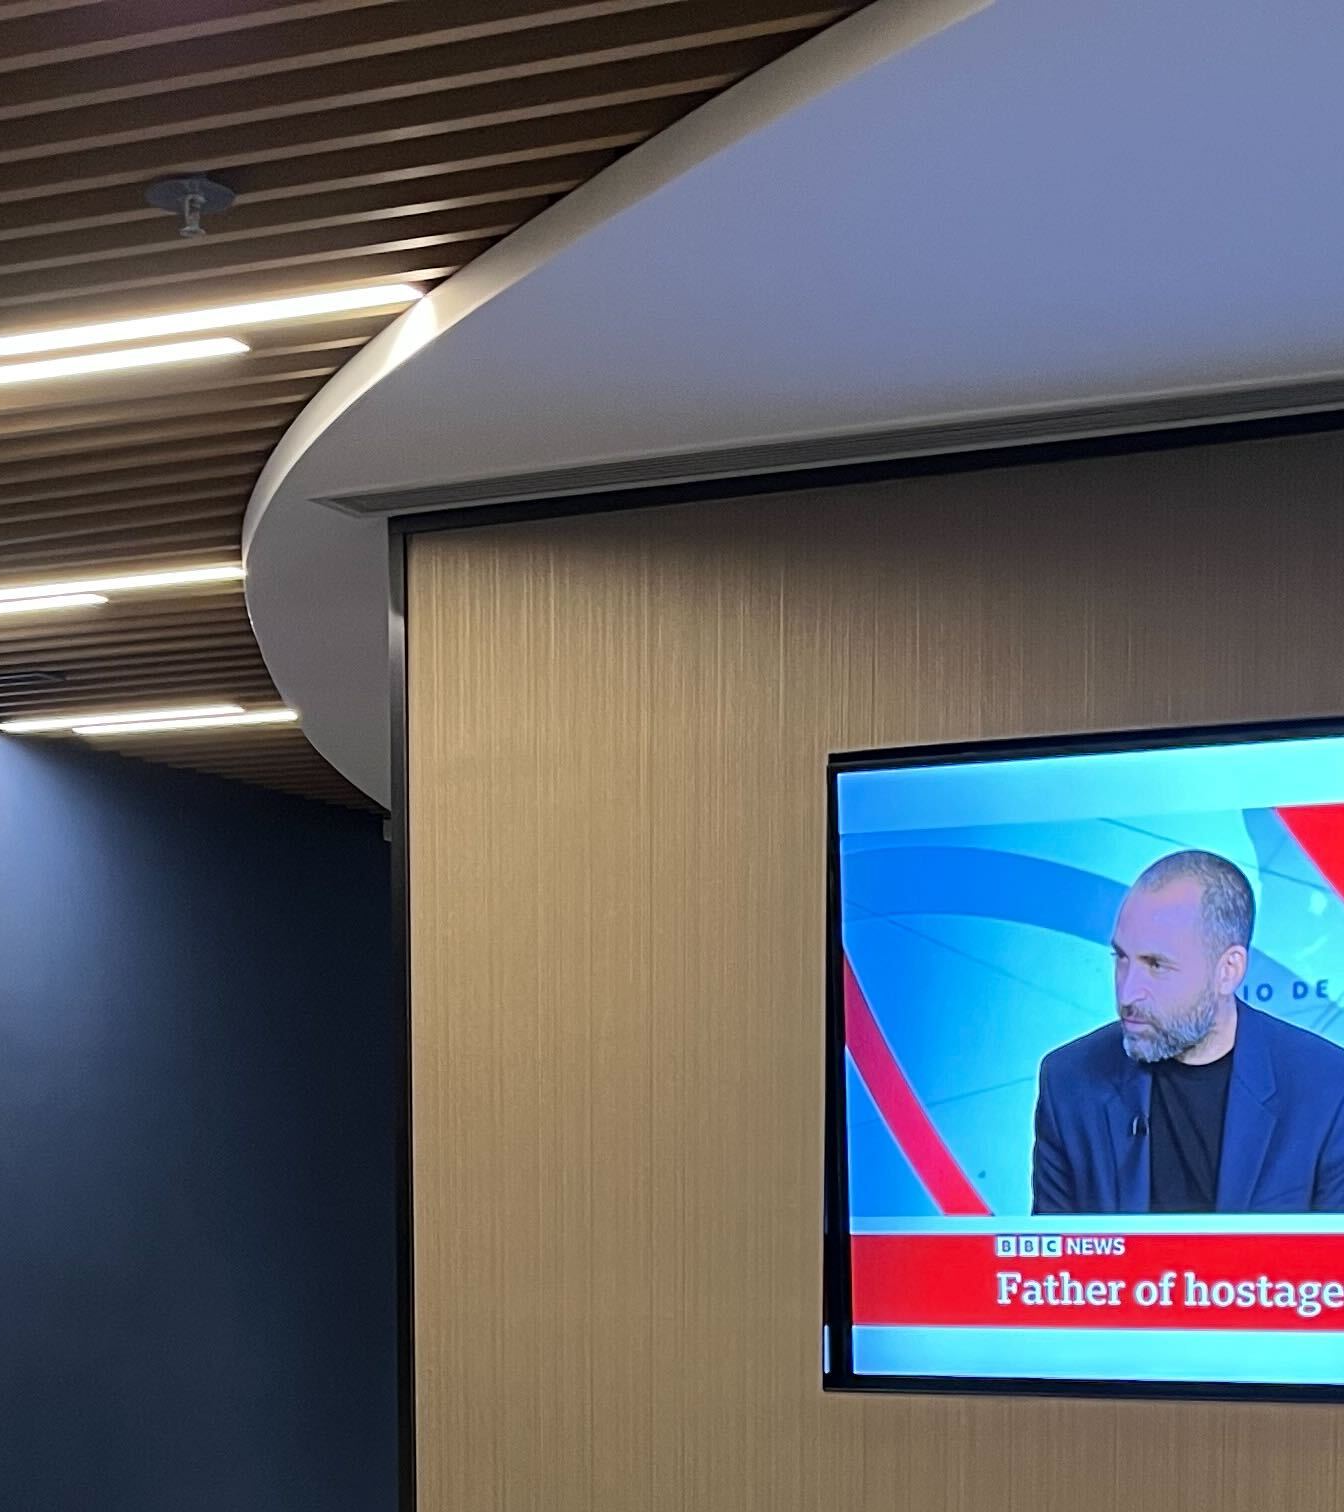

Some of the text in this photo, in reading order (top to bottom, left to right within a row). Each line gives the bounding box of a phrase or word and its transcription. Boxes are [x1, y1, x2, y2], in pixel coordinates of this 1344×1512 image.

[1243, 983, 1273, 1002] IO
[1292, 979, 1329, 1000] DE
[999, 1237, 1126, 1256] BBC NEWS
[996, 1271, 1126, 1306] Father
[1135, 1270, 1177, 1306] of
